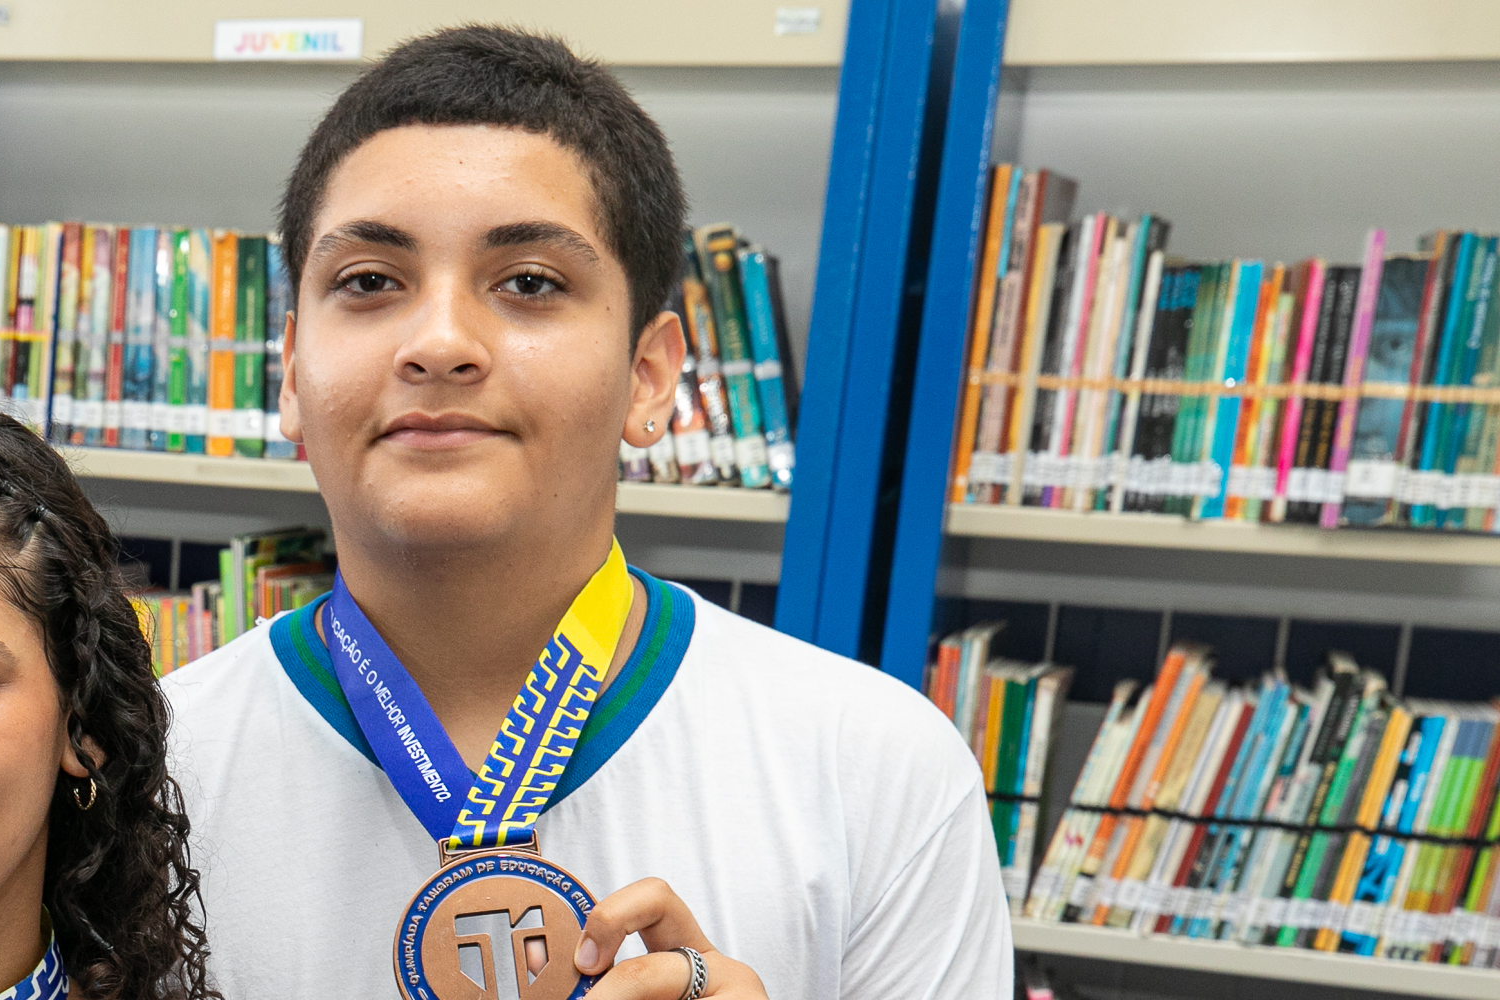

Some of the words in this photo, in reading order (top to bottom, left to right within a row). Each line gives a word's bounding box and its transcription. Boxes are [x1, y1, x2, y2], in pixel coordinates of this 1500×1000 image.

[235, 31, 343, 53] JUVENIL
[358, 658, 371, 675] É
[366, 670, 378, 685] O
[373, 680, 406, 728] MELHOR
[396, 723, 452, 803] INVESTIMENTO.
[417, 866, 474, 912] TANGRAM
[476, 860, 496, 874] DE
